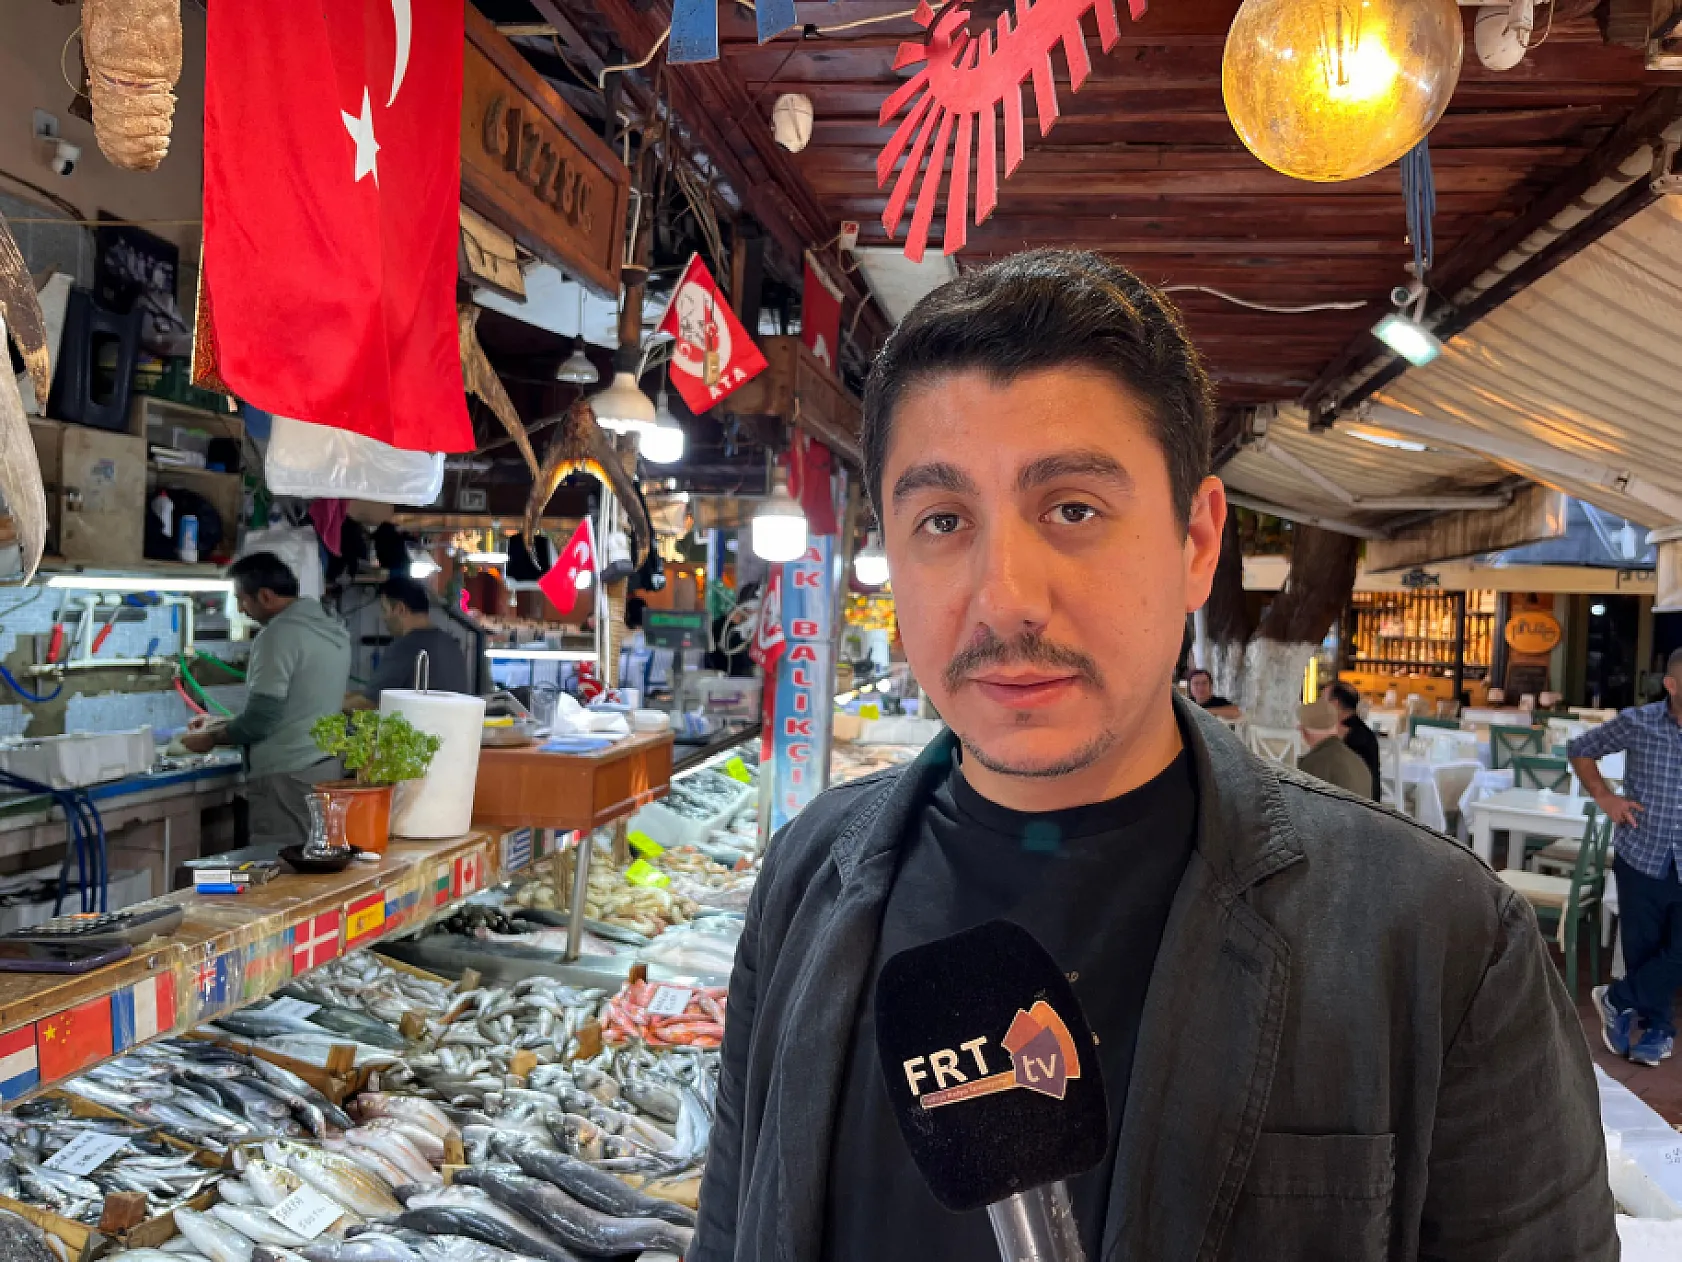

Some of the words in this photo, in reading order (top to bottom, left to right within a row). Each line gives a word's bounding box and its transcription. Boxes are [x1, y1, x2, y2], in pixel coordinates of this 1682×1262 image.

[709, 367, 747, 399] ATA
[903, 1035, 989, 1096] FRT
[1021, 1053, 1057, 1083] tv
